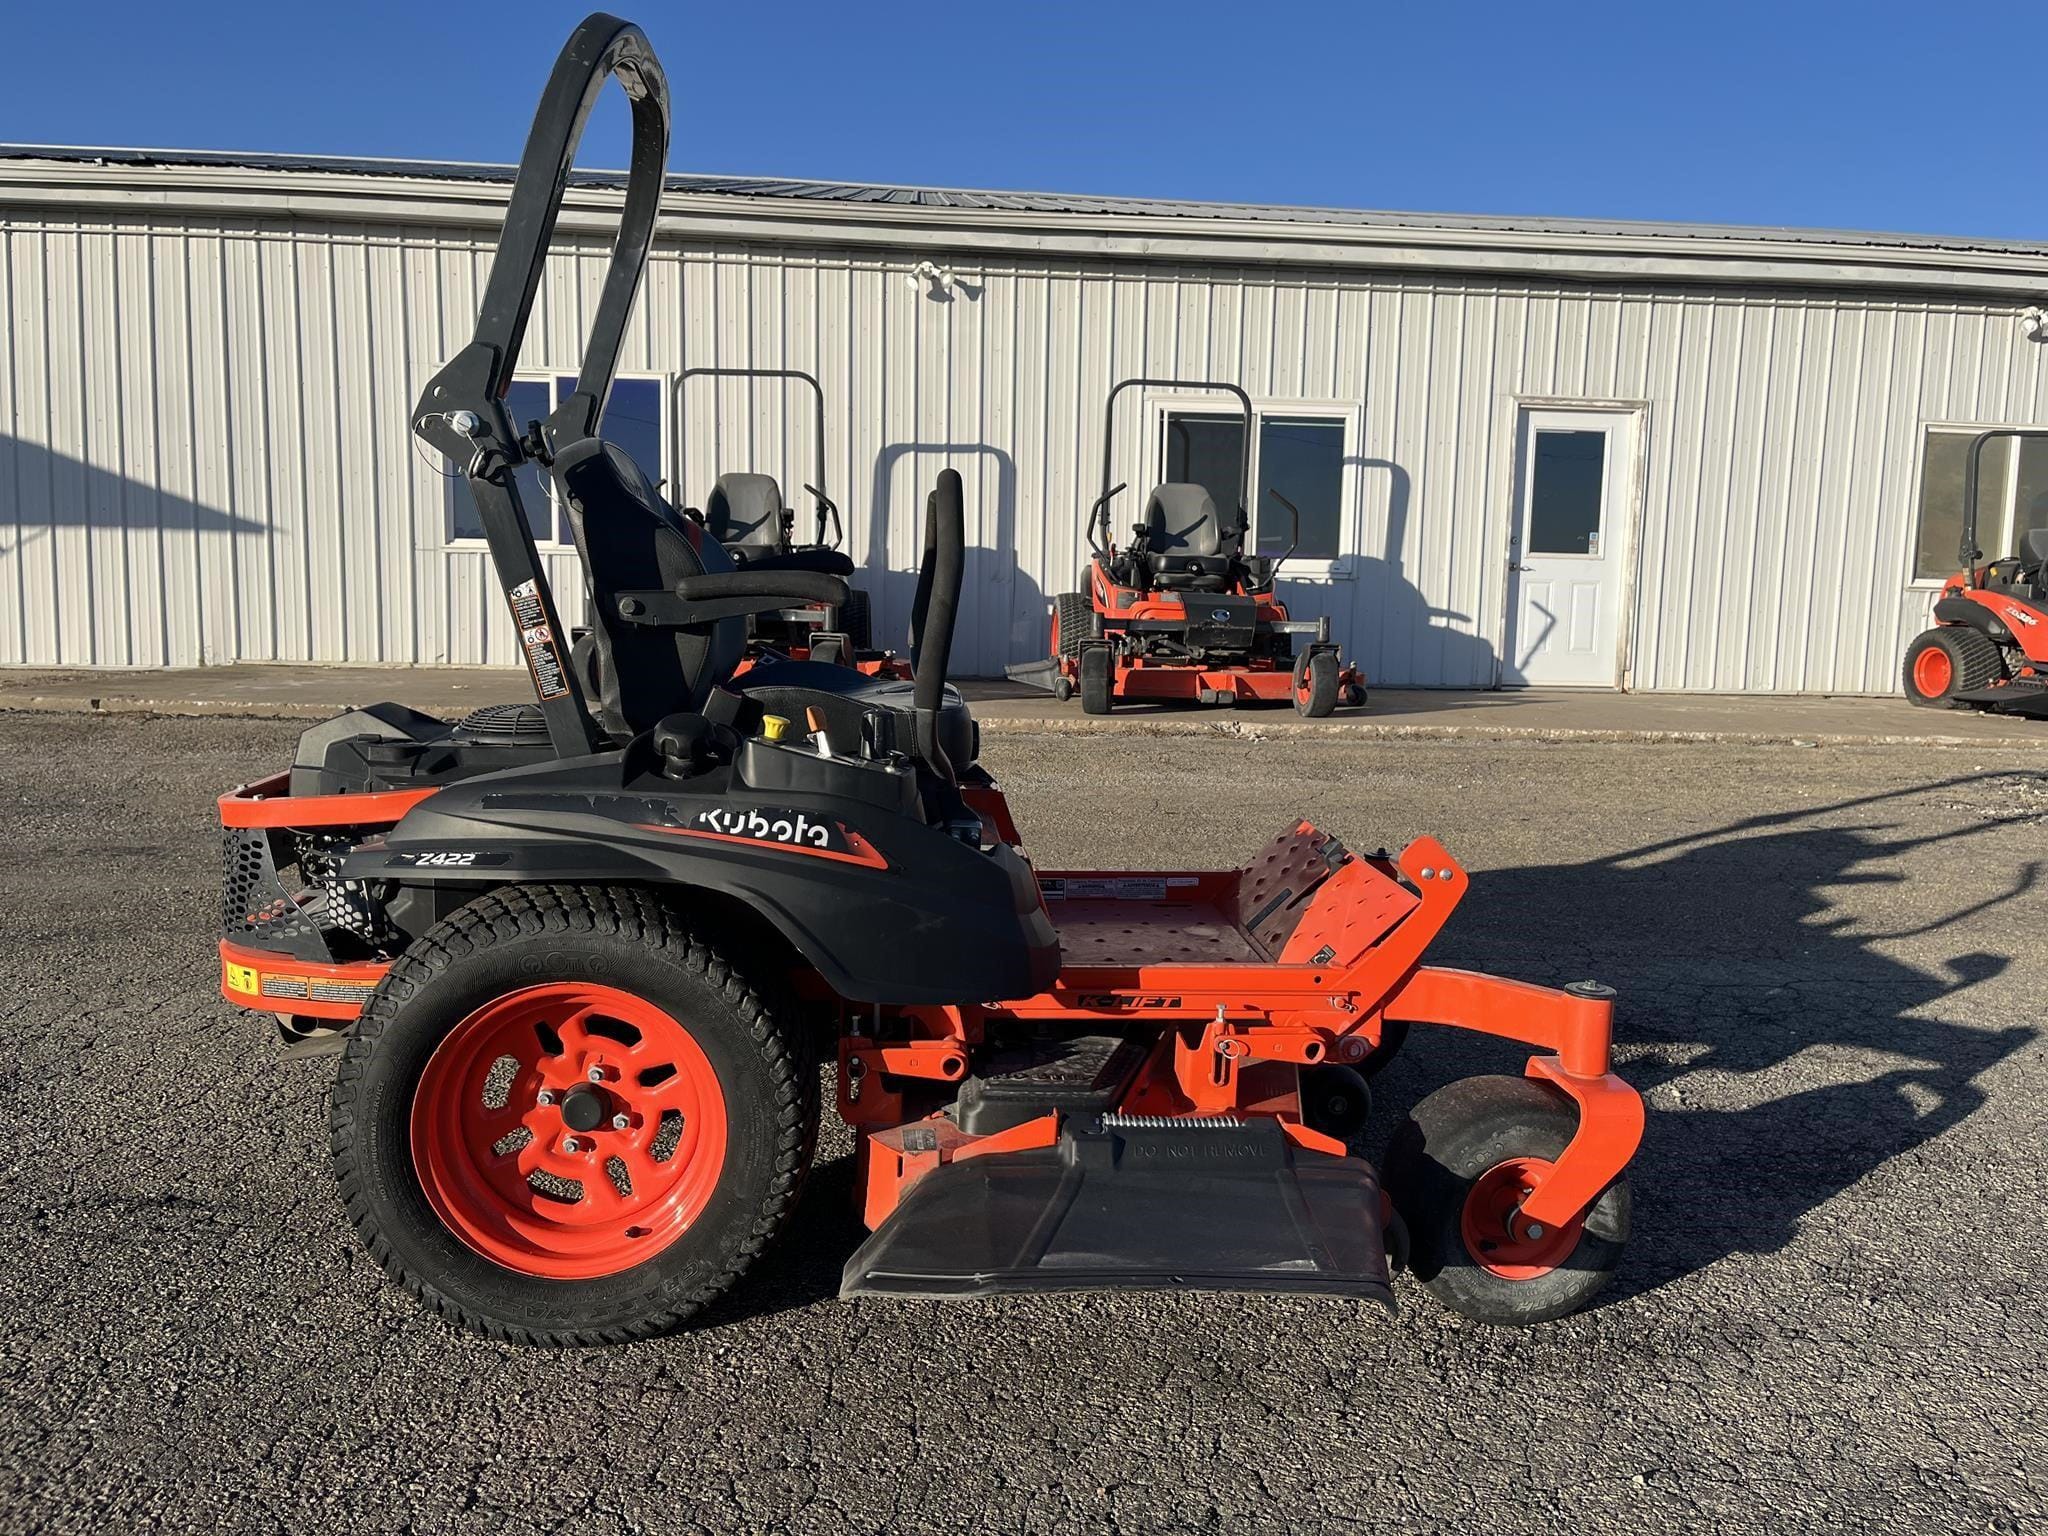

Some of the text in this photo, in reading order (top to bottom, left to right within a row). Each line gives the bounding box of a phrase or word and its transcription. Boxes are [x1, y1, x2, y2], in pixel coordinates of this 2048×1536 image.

[699, 808, 829, 848] Kubota
[1080, 995, 1181, 1008] K-LIFT
[369, 1079, 389, 1201] NOT FOR HIGHWAY SERVICE
[1133, 1144, 1158, 1159] DO
[1166, 1143, 1196, 1159] NOT
[438, 1270, 577, 1320] MASTER
